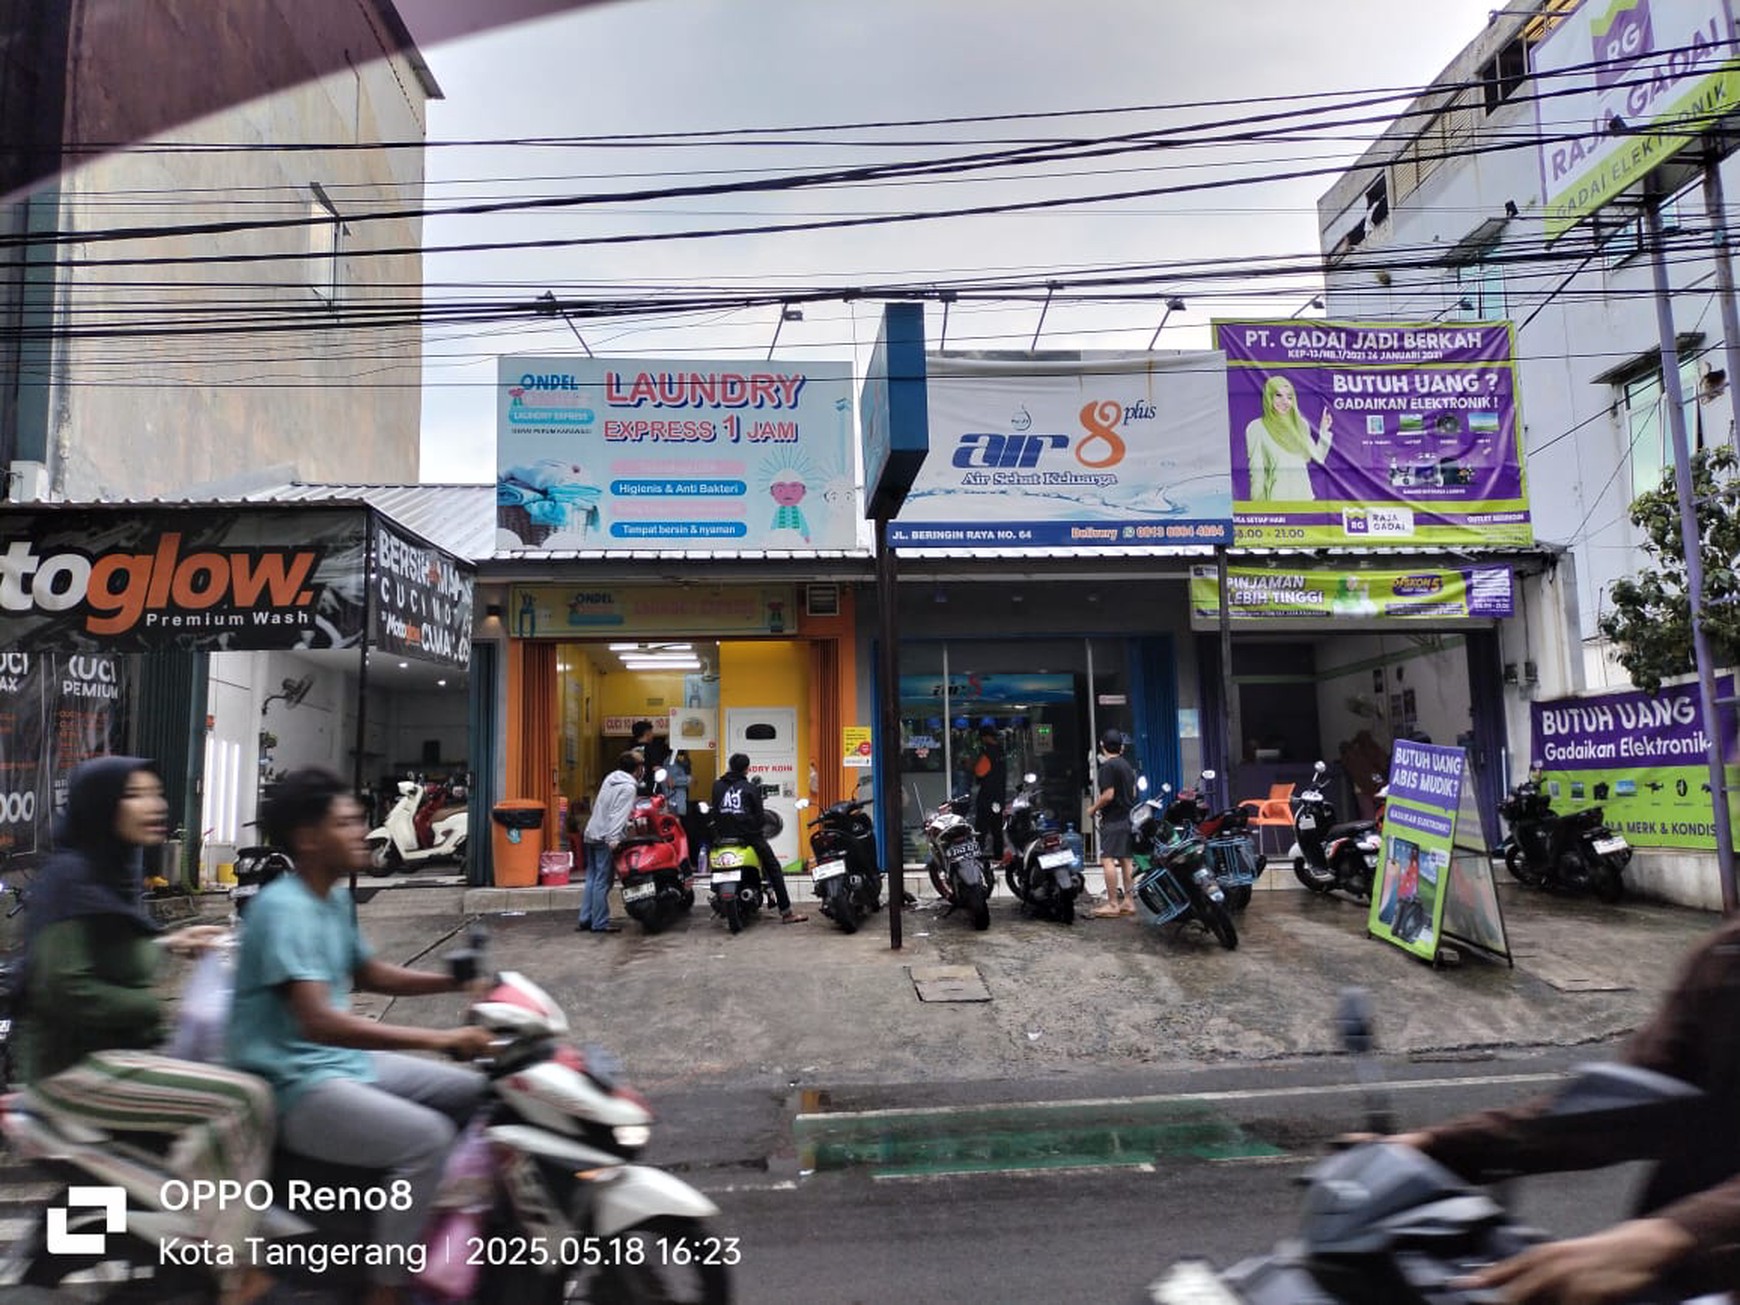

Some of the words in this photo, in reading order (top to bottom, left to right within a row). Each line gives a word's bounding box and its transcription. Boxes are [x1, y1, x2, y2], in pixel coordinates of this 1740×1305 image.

[1551, 107, 1624, 182] RAJA
[1626, 17, 1723, 118] GADAI
[1556, 174, 1607, 218] GADAI
[1612, 80, 1728, 182] ELEKTONIK
[1245, 330, 1276, 348] PT.
[1280, 330, 1347, 351] GADAI
[1353, 332, 1399, 350] JADI
[1403, 332, 1483, 350] BERKAH
[520, 373, 579, 391] ONDEL
[604, 371, 806, 409] LAUNDRY
[1332, 374, 1410, 394] BUTUH
[1414, 374, 1480, 394] UANG
[1485, 374, 1499, 392] ?
[1123, 400, 1157, 426] plus
[1333, 396, 1407, 411] GADAIKAN
[1410, 395, 1490, 411] ELEKTRONIK
[603, 420, 716, 442] EXPRESS
[722, 415, 740, 443] 1
[747, 421, 799, 443] JAM
[952, 432, 1070, 469] air
[1075, 400, 1126, 469] 8
[619, 483, 663, 495] Higienis
[664, 484, 674, 494] &
[675, 483, 698, 494] Anti
[699, 483, 739, 494] Bakteri
[961, 473, 991, 485] Air
[1042, 471, 1118, 488] Keluarga
[1372, 513, 1399, 522] RAJA
[892, 530, 909, 540] JL.
[911, 530, 964, 541] BERINGIN
[965, 530, 996, 540] RAYA
[997, 530, 1017, 540] NO.
[1274, 528, 1305, 539] 21.00
[1227, 575, 1305, 590] PINJAMAN
[1227, 591, 1268, 605] LEBIH
[1273, 591, 1324, 604] TINGGI
[146, 613, 245, 627] Premium
[253, 611, 309, 625] Wash
[1542, 705, 1615, 736] BUTUH
[1616, 696, 1696, 731] UANG
[1544, 739, 1616, 761] Gadaikan
[1394, 747, 1431, 770] BUTUH
[1432, 753, 1462, 776] UANG
[1392, 768, 1419, 790] ABIS
[1418, 773, 1459, 799] MUDIK?
[1626, 821, 1657, 834] MERK
[1660, 822, 1669, 834] &
